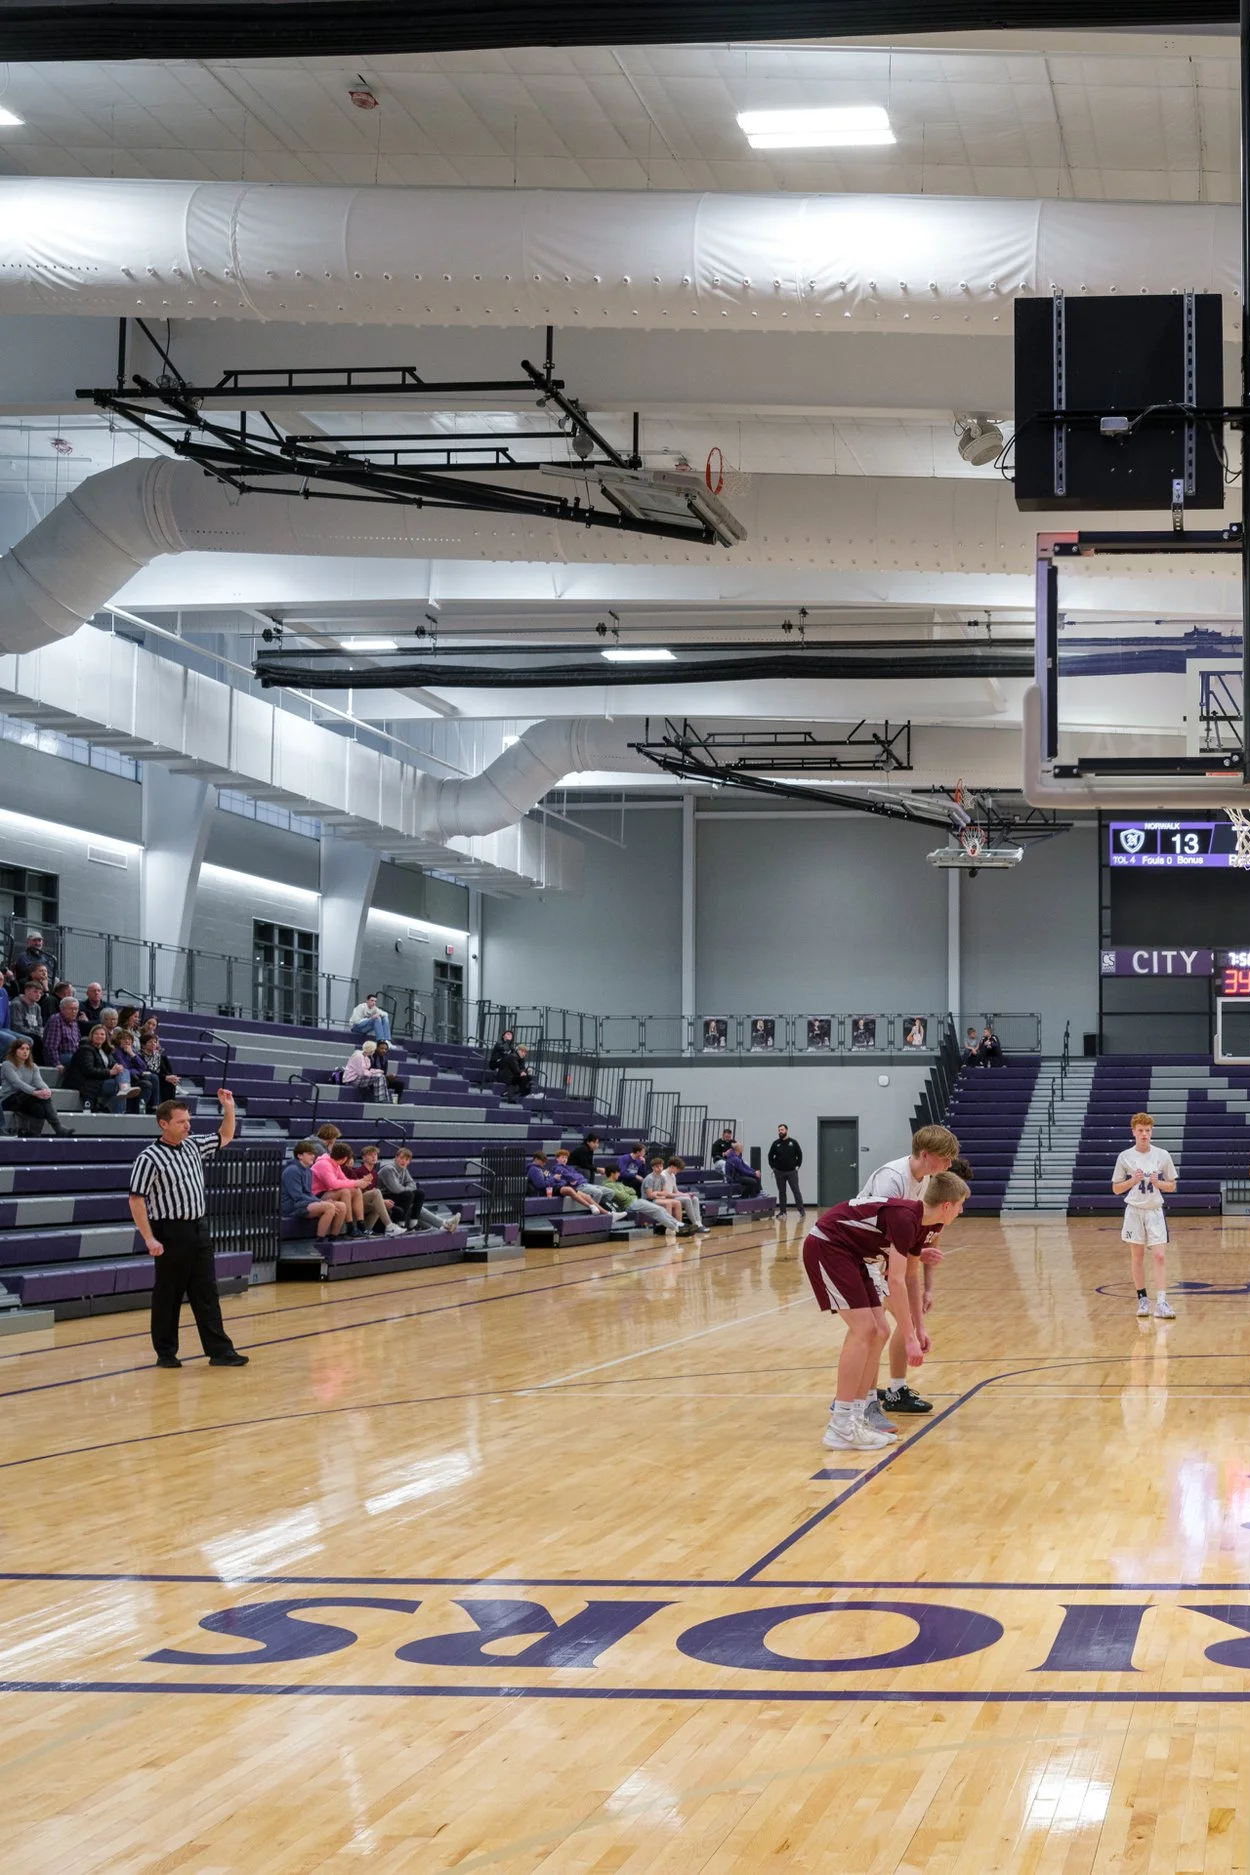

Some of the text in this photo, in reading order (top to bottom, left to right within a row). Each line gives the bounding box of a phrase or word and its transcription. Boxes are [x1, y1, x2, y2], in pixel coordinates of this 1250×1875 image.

[1172, 833, 1199, 854] 13
[1142, 856, 1164, 865] Fouls
[1177, 855, 1204, 864] Bonus
[1132, 951, 1198, 974] CITY
[1138, 1180, 1154, 1194] 44
